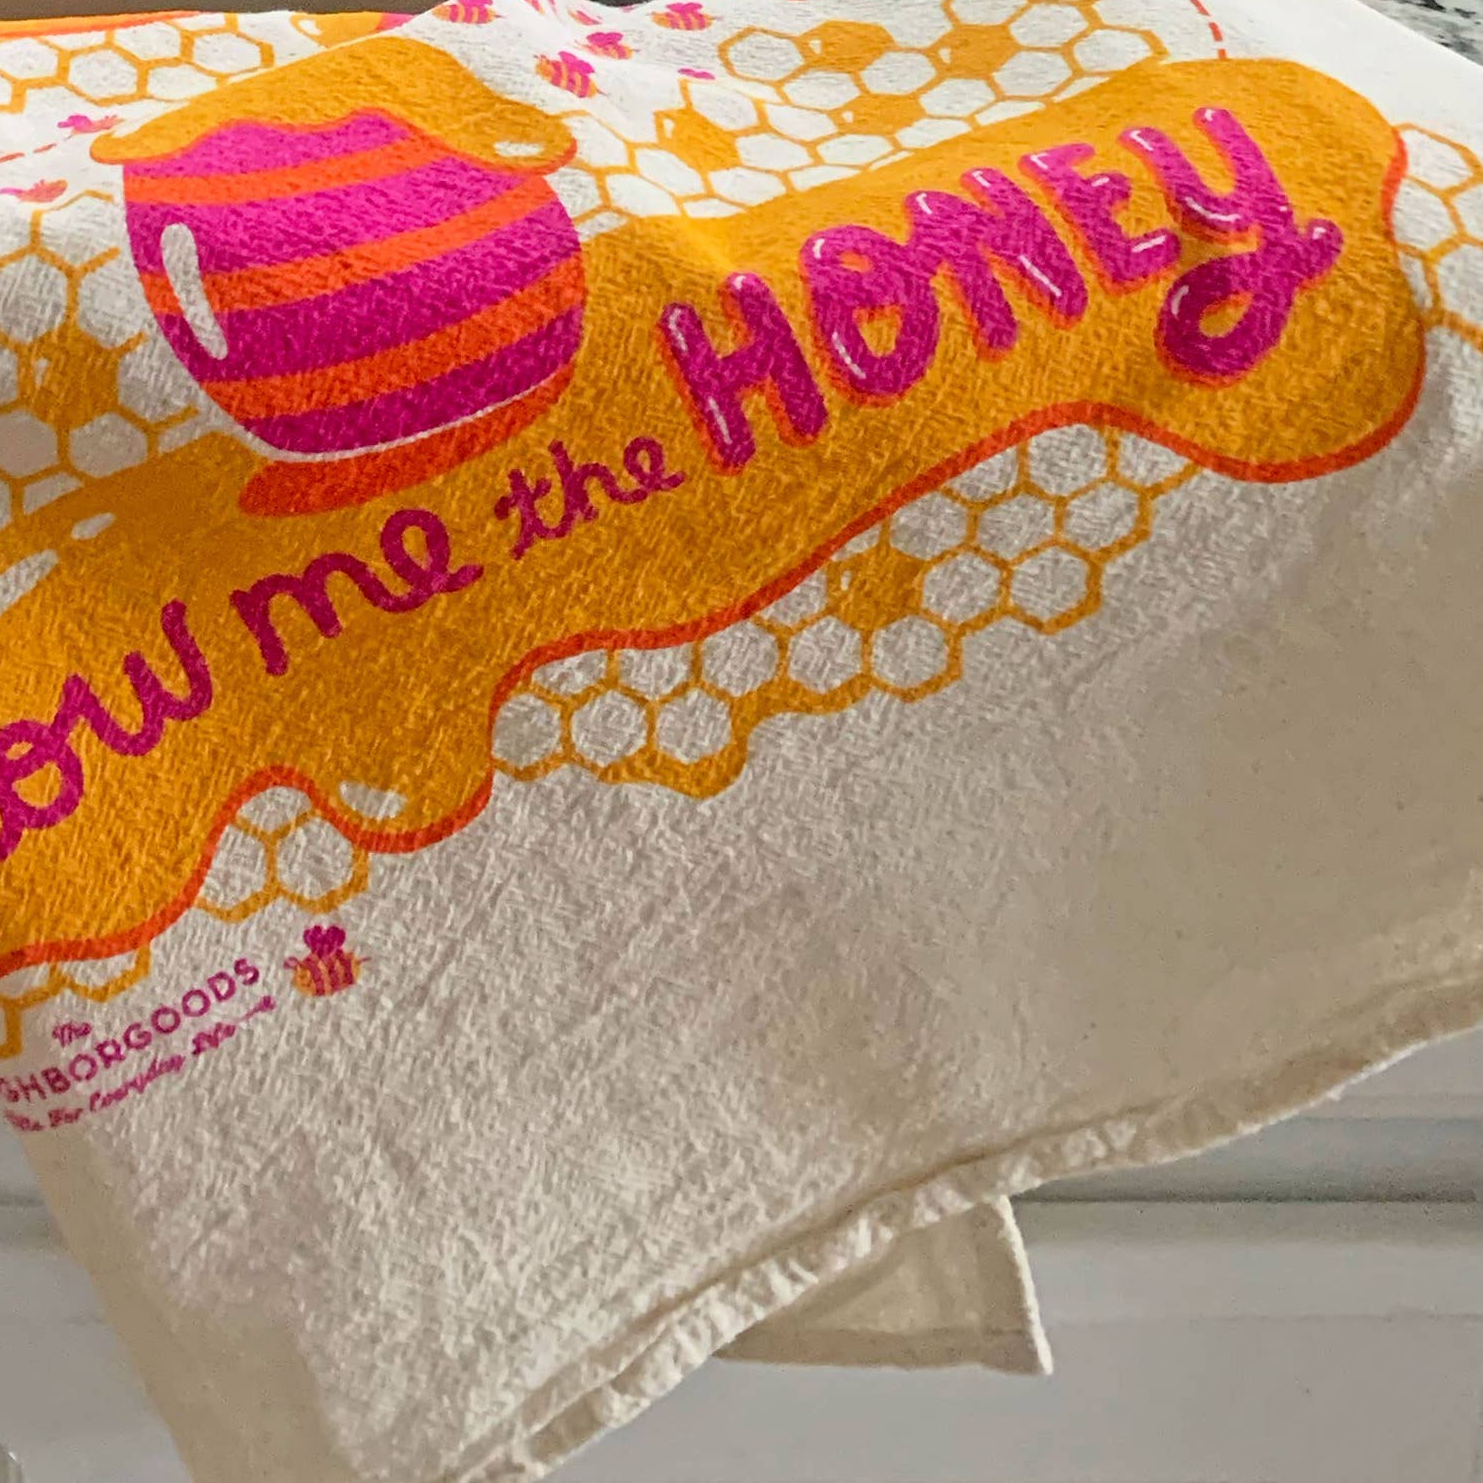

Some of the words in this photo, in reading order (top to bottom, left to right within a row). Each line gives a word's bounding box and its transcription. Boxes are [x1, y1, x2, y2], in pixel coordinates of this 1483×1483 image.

[229, 508, 484, 676] me
[494, 437, 685, 560] the
[657, 106, 1344, 476] HONEY
